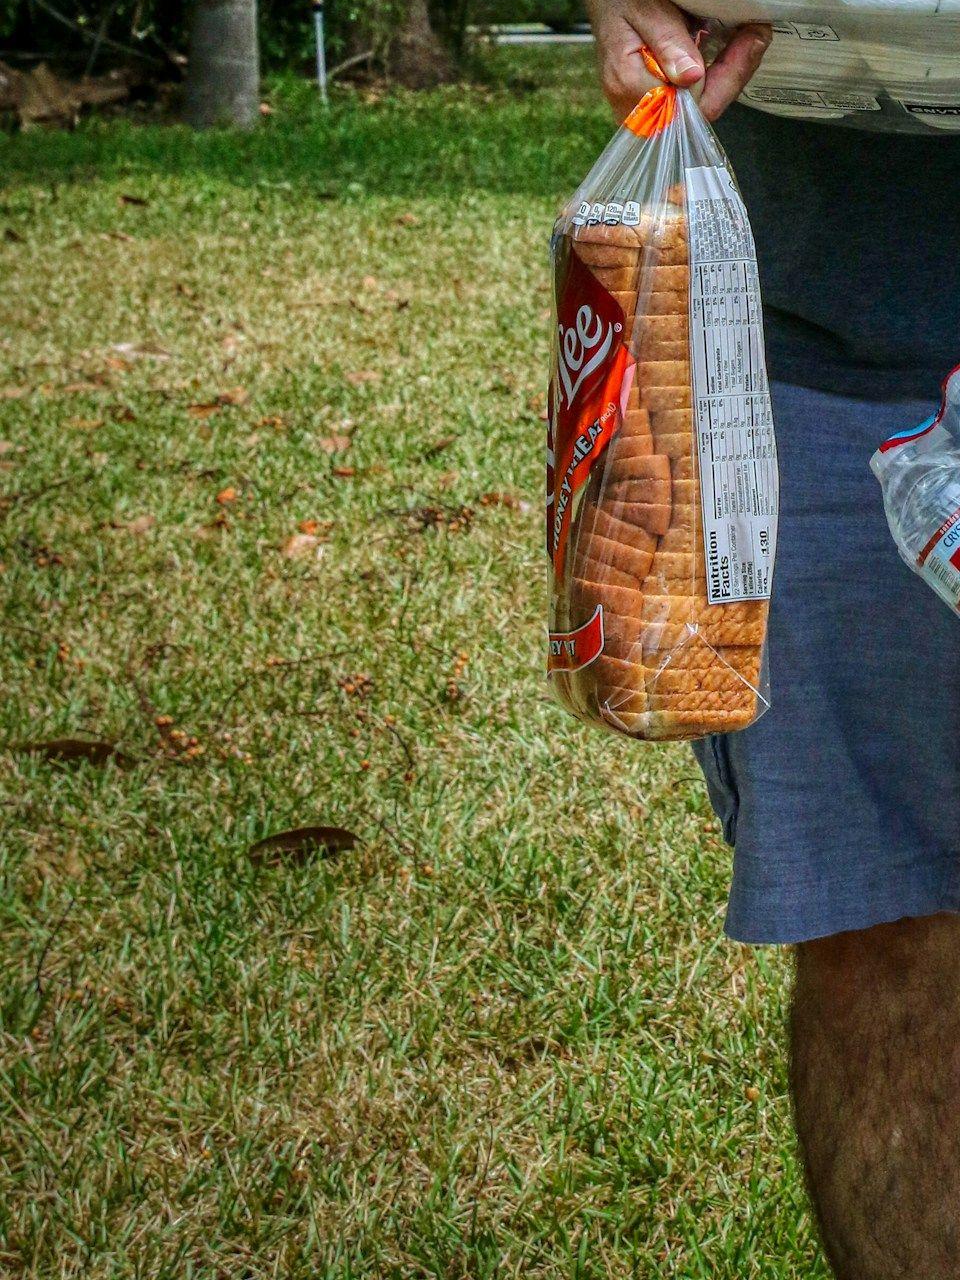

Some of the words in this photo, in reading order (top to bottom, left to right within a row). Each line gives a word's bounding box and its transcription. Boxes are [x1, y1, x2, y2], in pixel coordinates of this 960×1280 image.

[759, 530, 768, 555] 130
[709, 531, 721, 598] Nutrition
[720, 556, 731, 597] Facts
